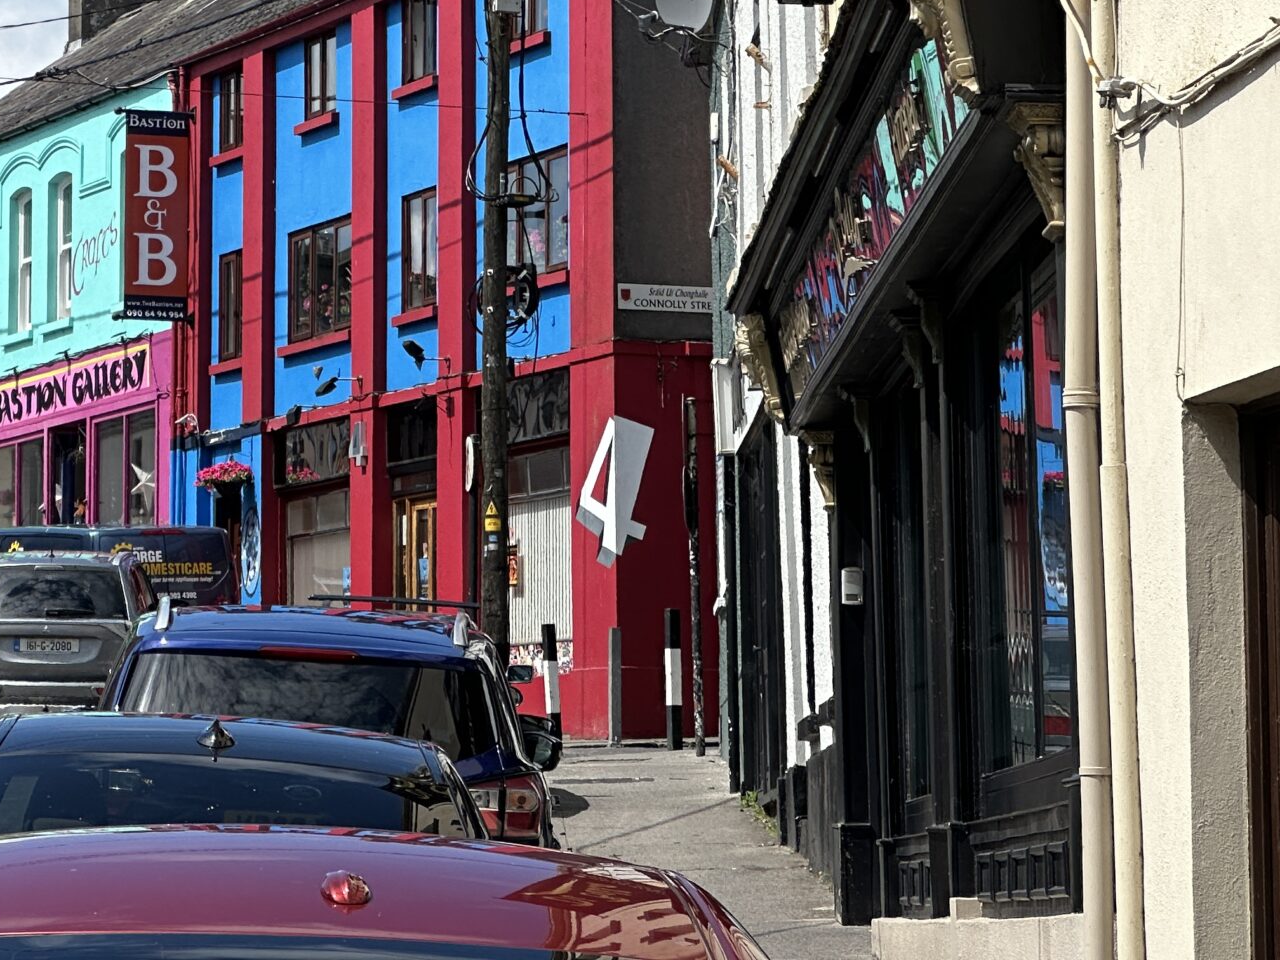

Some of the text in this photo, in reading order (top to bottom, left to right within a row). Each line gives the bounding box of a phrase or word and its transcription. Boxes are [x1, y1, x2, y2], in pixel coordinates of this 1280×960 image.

[633, 298, 688, 310] CONNOLLY
[126, 309, 143, 317] 090
[156, 310, 167, 318] 94
[72, 348, 148, 406] GALLERY
[576, 415, 655, 569] 4
[142, 562, 213, 576] OMESTICARE
[26, 641, 72, 651] 161-G-2080
